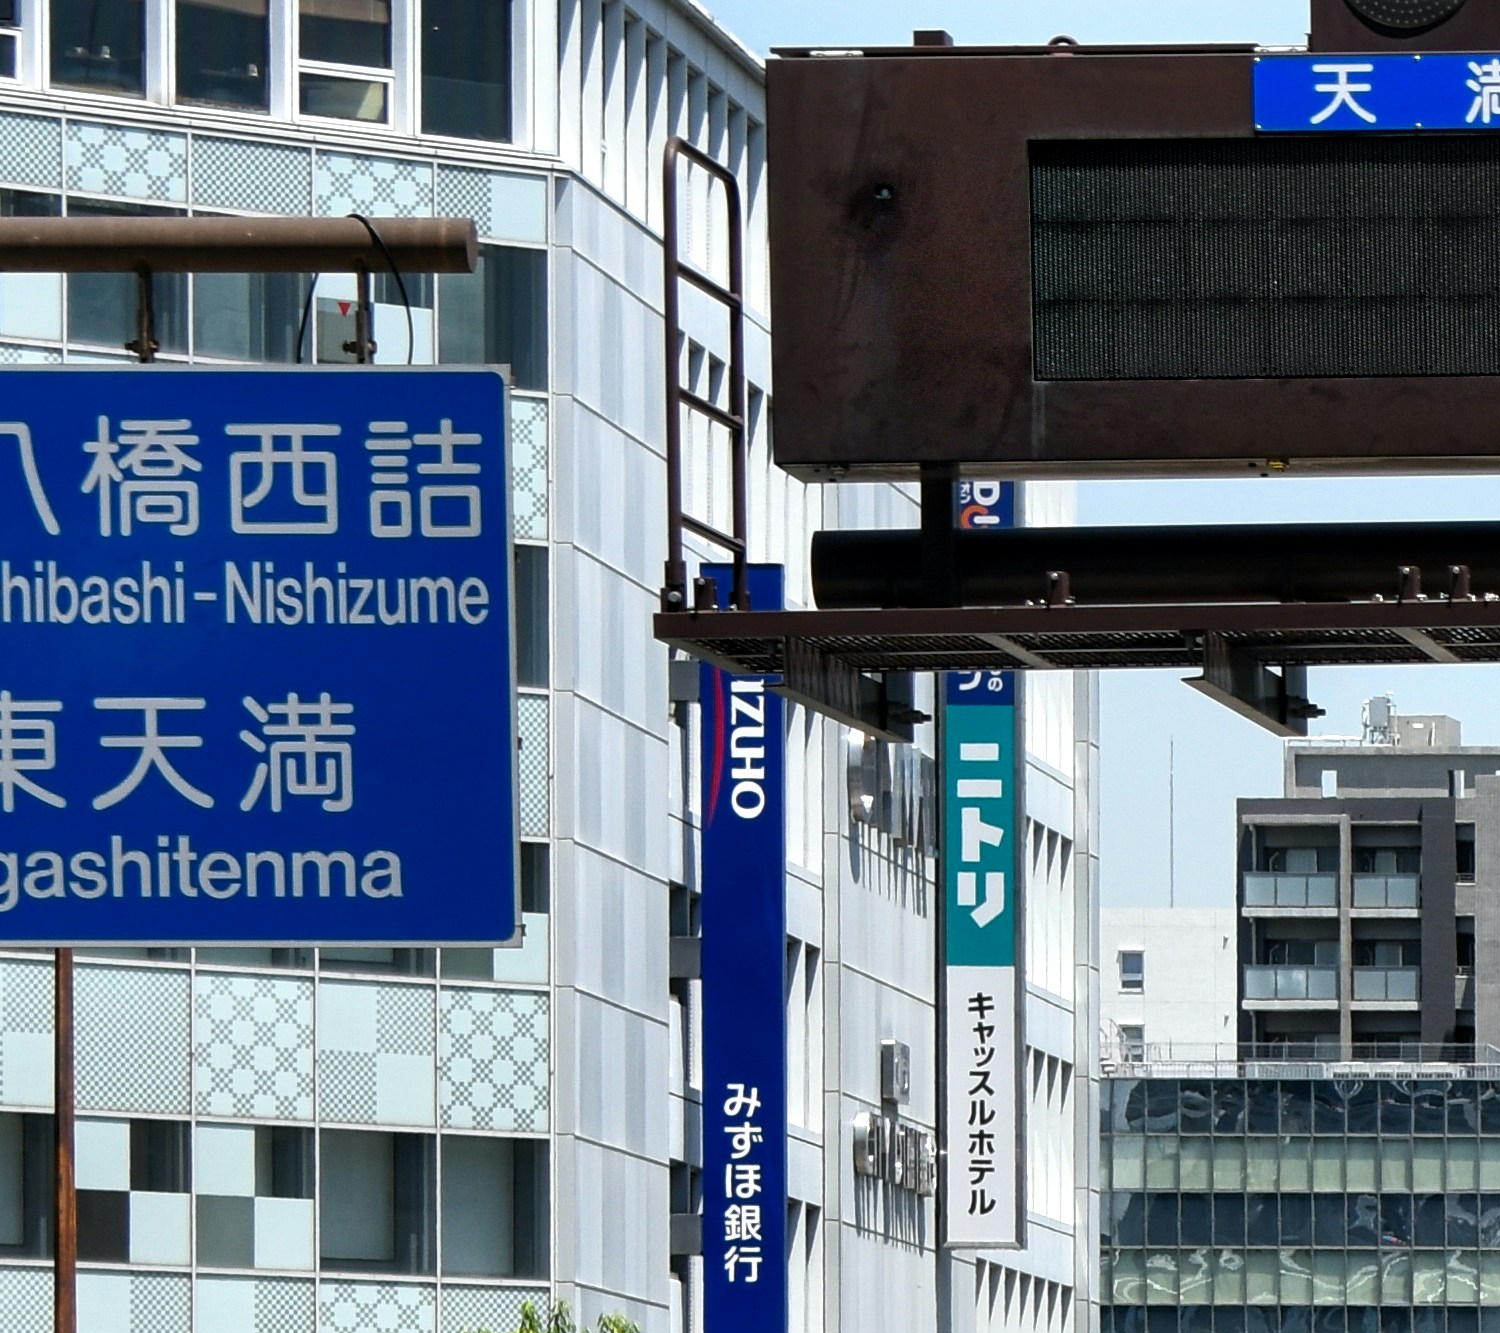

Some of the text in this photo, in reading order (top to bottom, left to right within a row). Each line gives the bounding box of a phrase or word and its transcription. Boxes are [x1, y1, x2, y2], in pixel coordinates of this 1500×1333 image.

[0, 691, 356, 812] 東天満
[730, 678, 766, 820] IZUHO
[956, 742, 1005, 929] ニトリ
[723, 1083, 764, 1283] みずほ銀行
[967, 992, 997, 1216] キャッスルホテル
